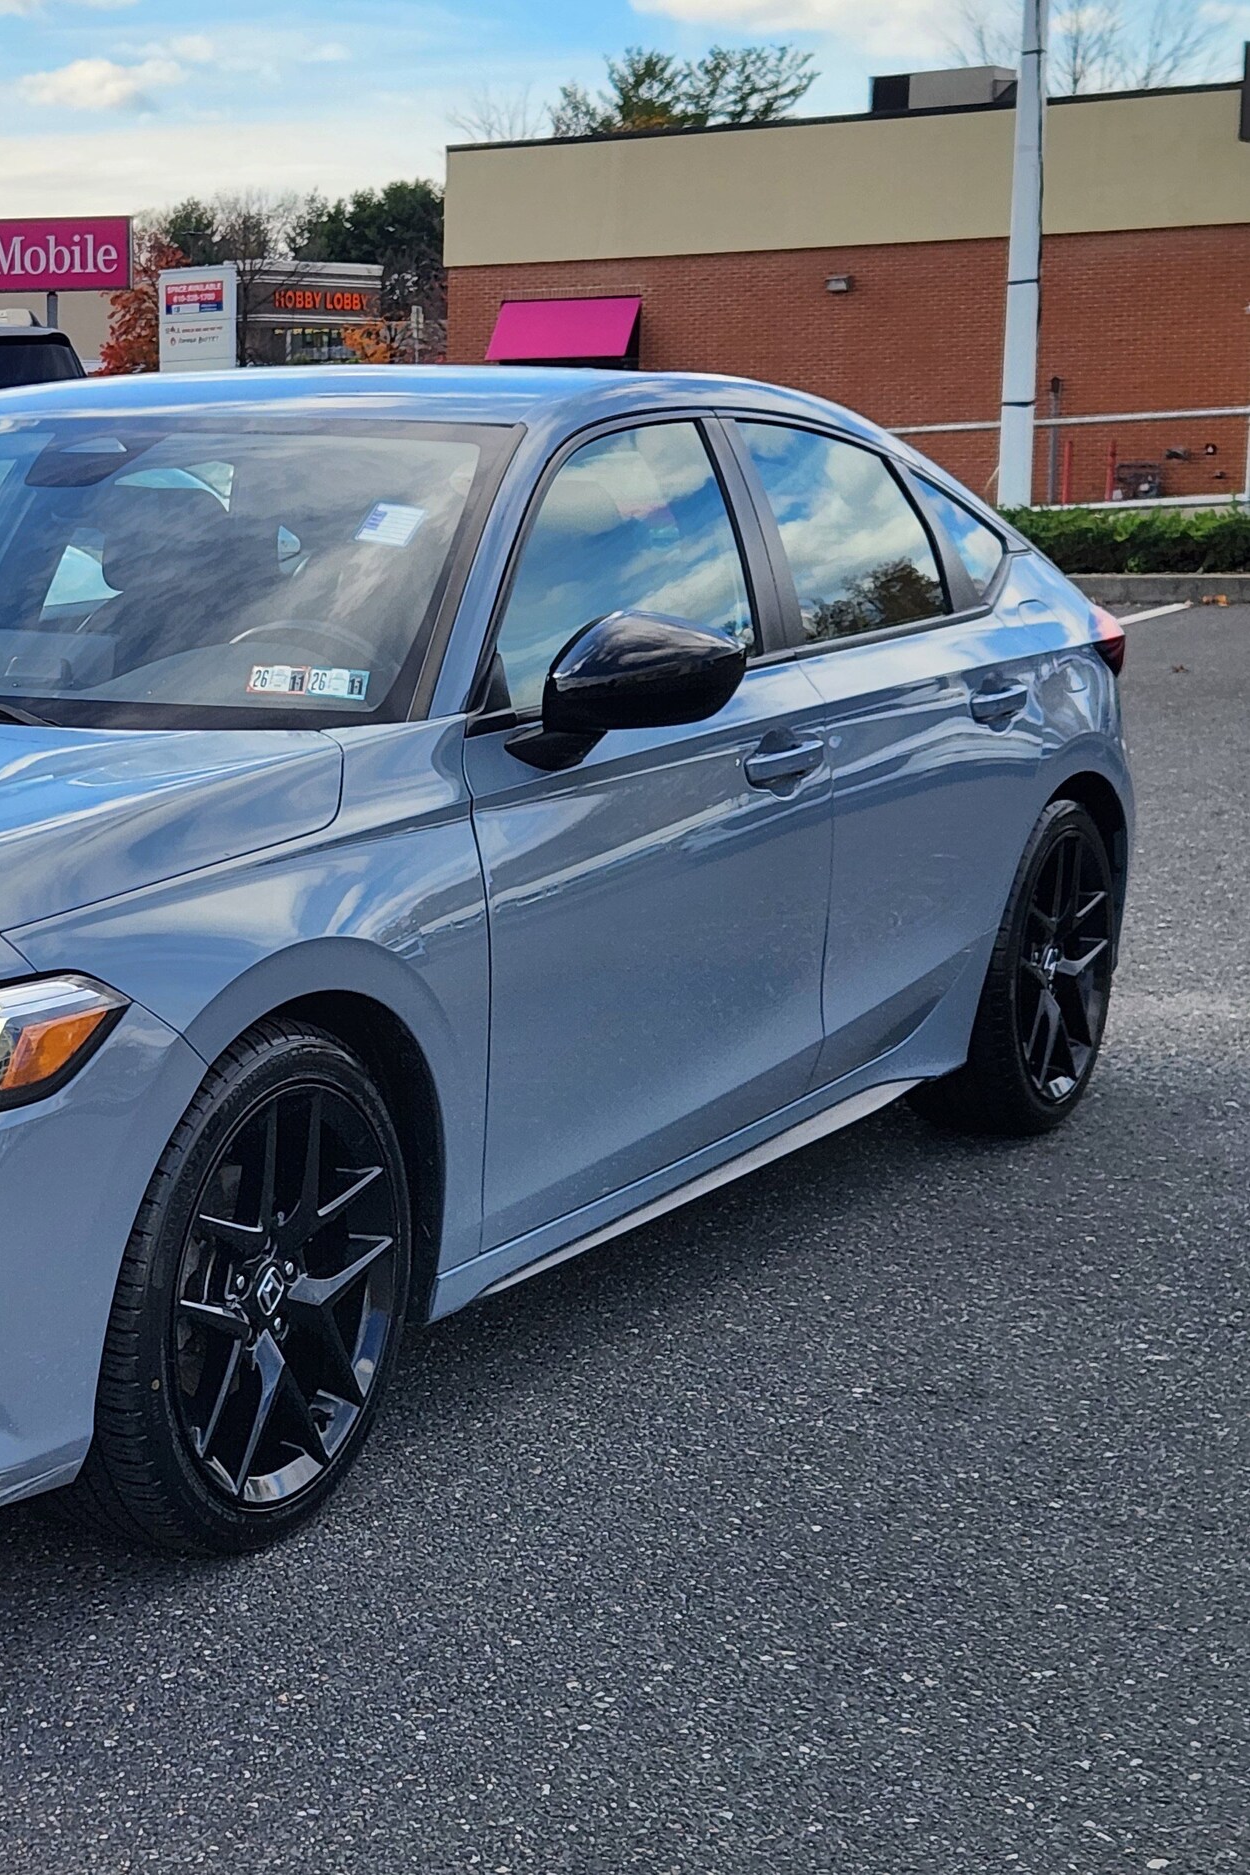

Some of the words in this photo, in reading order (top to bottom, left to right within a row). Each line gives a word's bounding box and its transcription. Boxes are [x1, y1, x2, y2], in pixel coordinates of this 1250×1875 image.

[274, 290, 321, 309] HOBBY
[325, 292, 368, 310] LOBBY
[253, 669, 269, 688] 26
[290, 674, 305, 691] 11
[310, 672, 327, 691] 26
[349, 677, 364, 695] 11
